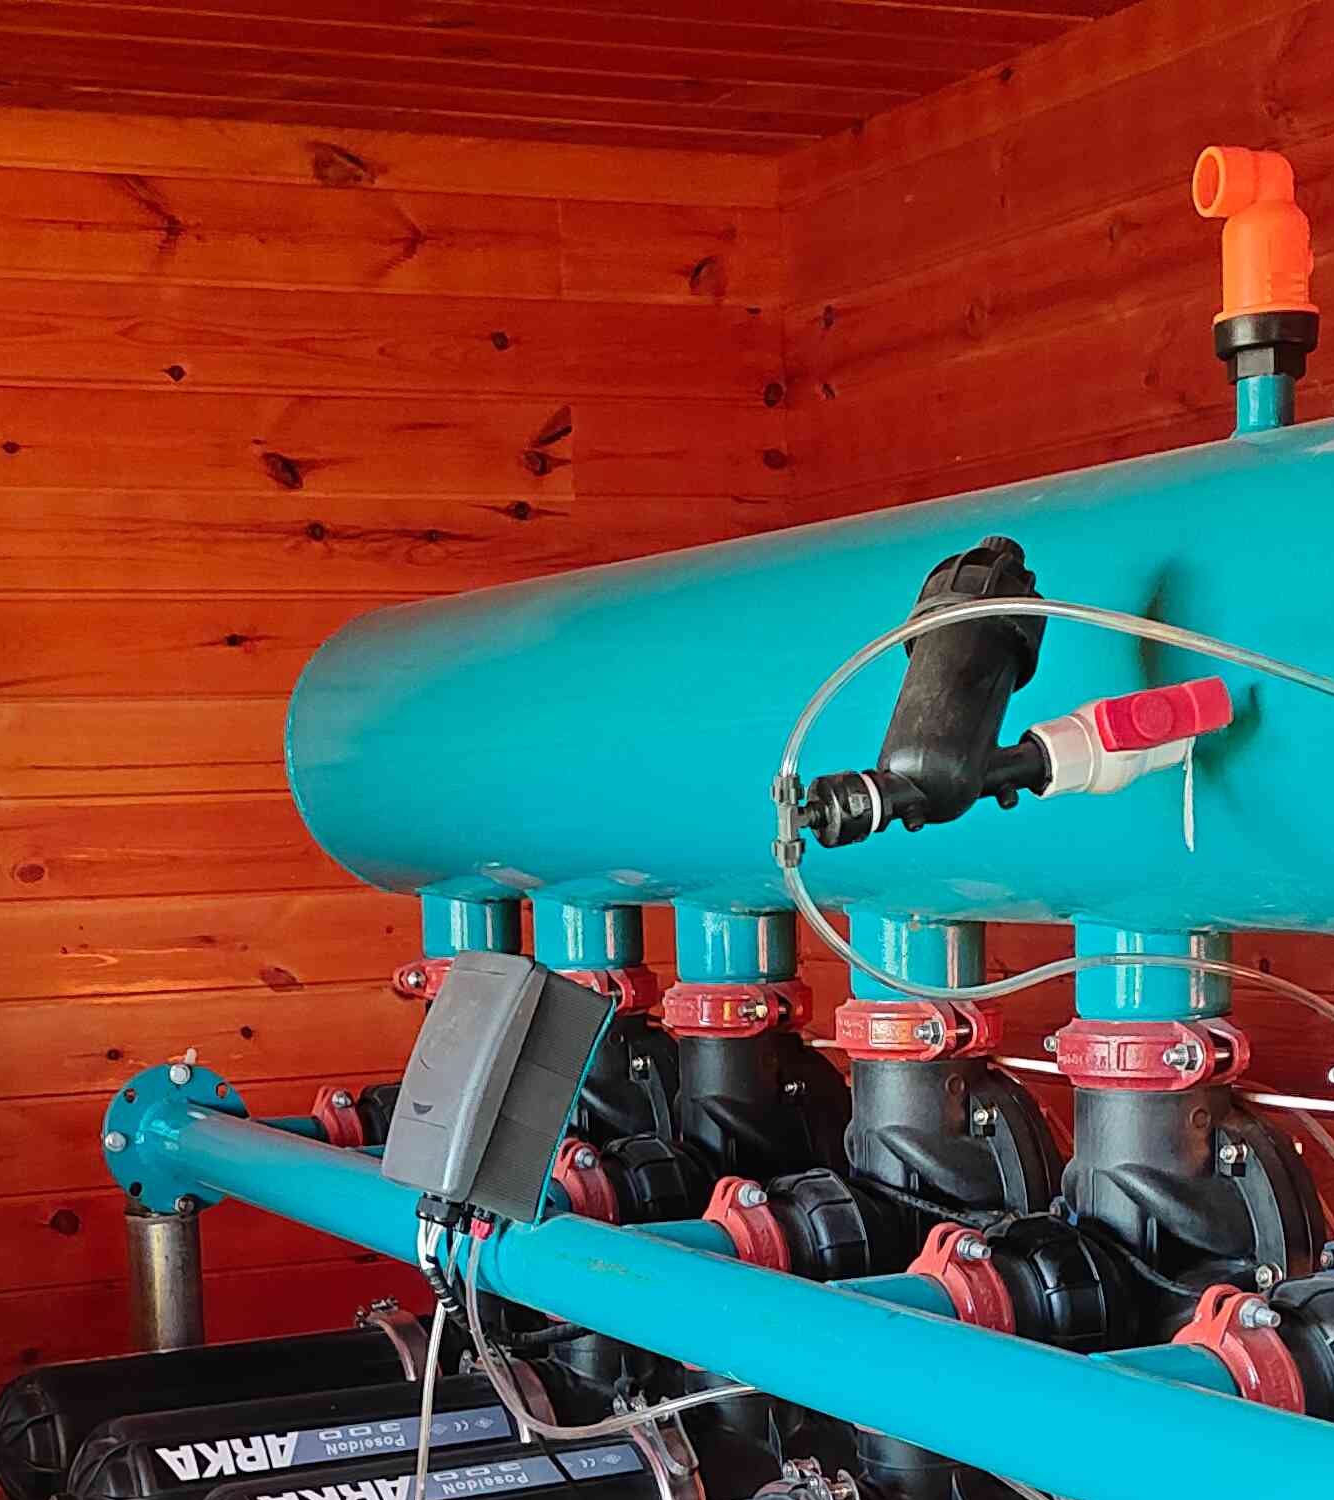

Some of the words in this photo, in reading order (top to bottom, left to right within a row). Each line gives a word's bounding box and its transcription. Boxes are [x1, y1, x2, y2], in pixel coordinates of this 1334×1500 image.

[319, 1421, 402, 1440] 300
[154, 1431, 298, 1481] ARKA
[326, 1434, 407, 1456] PoseidoN
[433, 1462, 522, 1482] 300
[442, 1473, 529, 1495] PoseidoN
